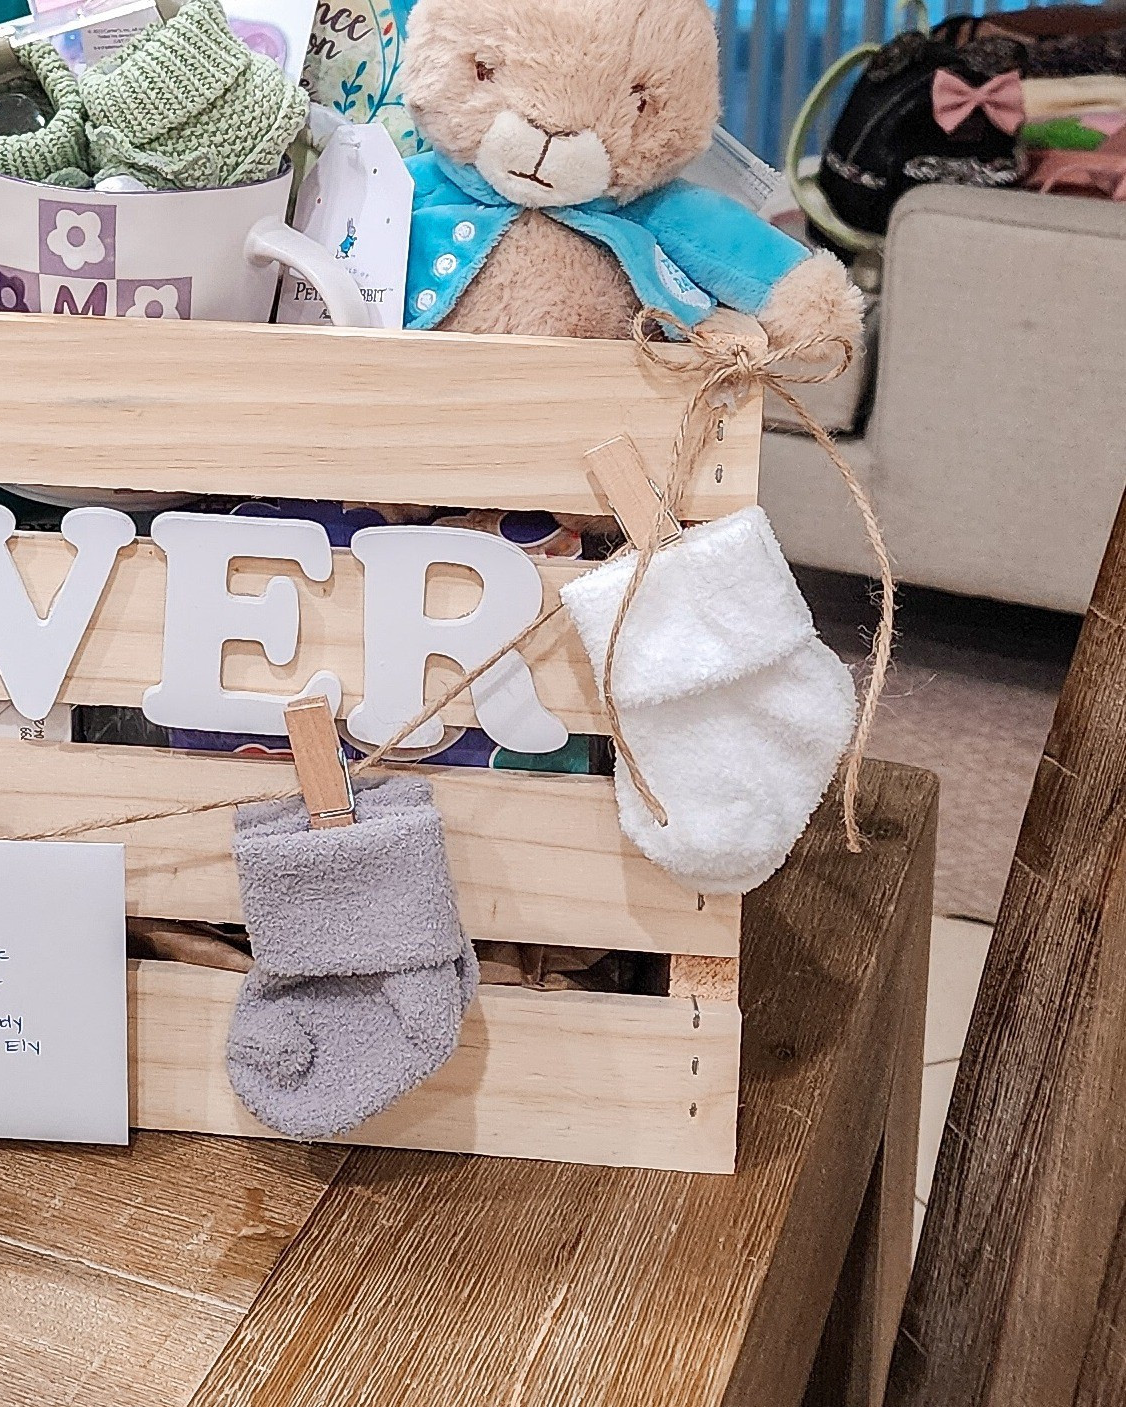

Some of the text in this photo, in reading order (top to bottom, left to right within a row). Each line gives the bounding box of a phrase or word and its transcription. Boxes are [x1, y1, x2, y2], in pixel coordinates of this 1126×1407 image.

[317, 1, 374, 41] nce
[294, 281, 388, 303] PET BBIT
